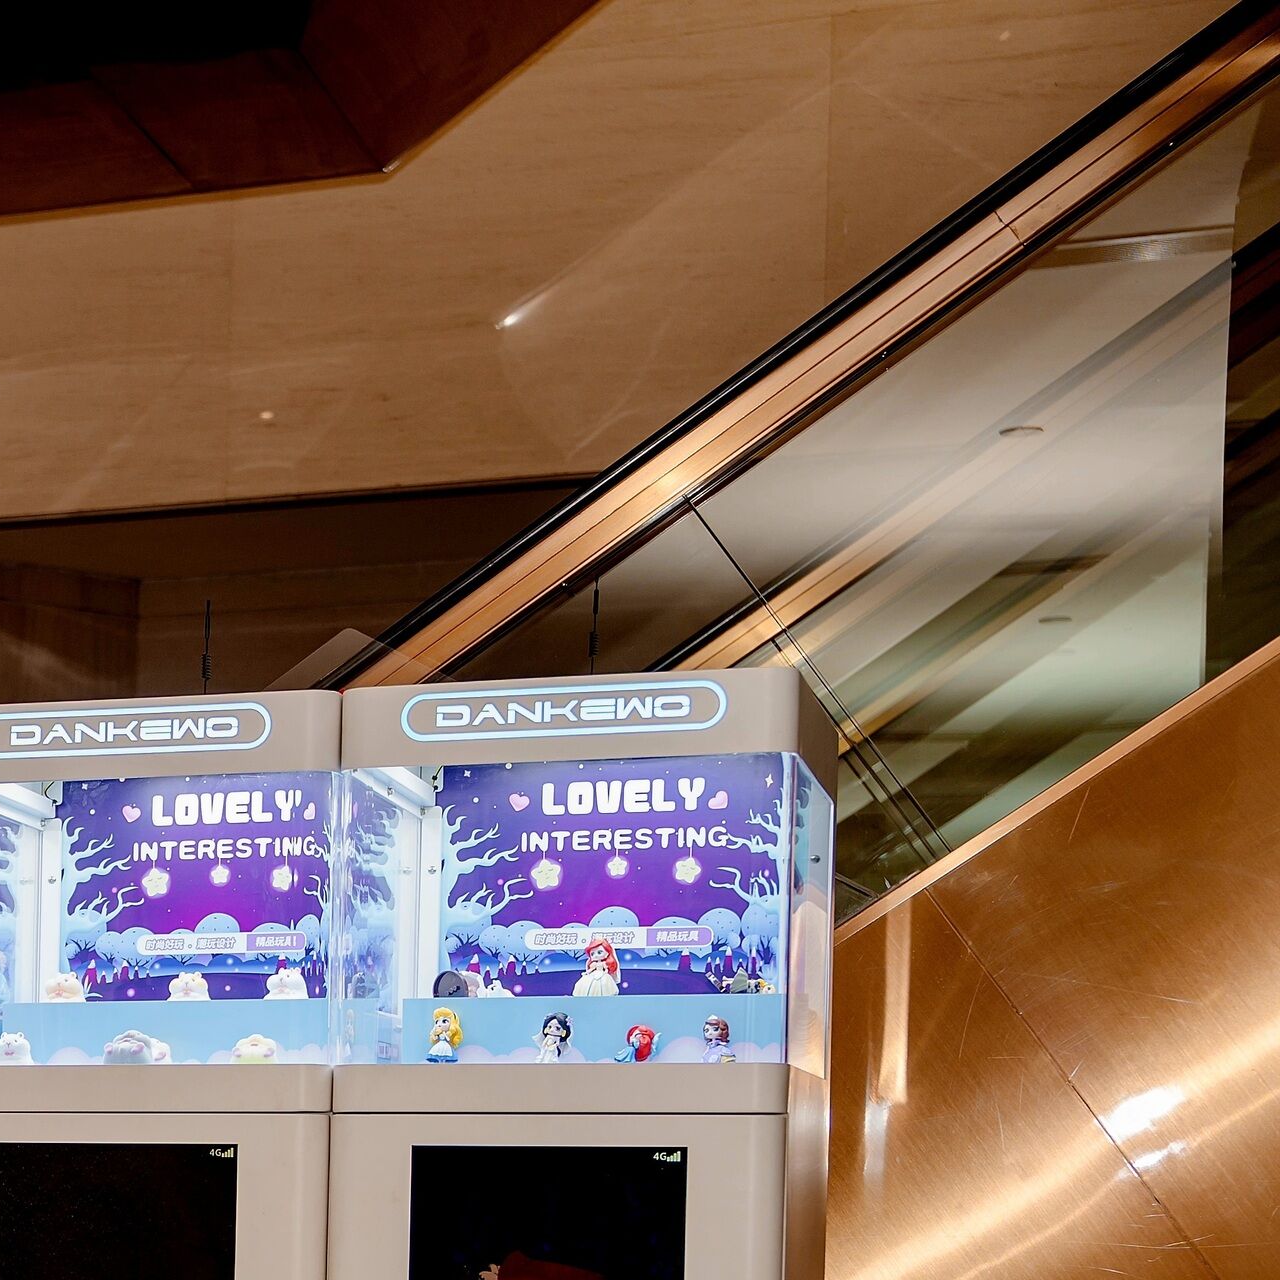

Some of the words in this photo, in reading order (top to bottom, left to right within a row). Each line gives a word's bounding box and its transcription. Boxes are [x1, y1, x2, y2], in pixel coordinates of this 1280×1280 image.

[435, 695, 693, 727] DANKEWO
[10, 716, 239, 746] DANKEWO
[152, 790, 295, 826] LOVELY
[541, 777, 705, 814] LOVELY
[521, 824, 729, 852] INTERESTING
[535, 932, 578, 945] 时尚好玩
[655, 930, 700, 943] 精品玩具
